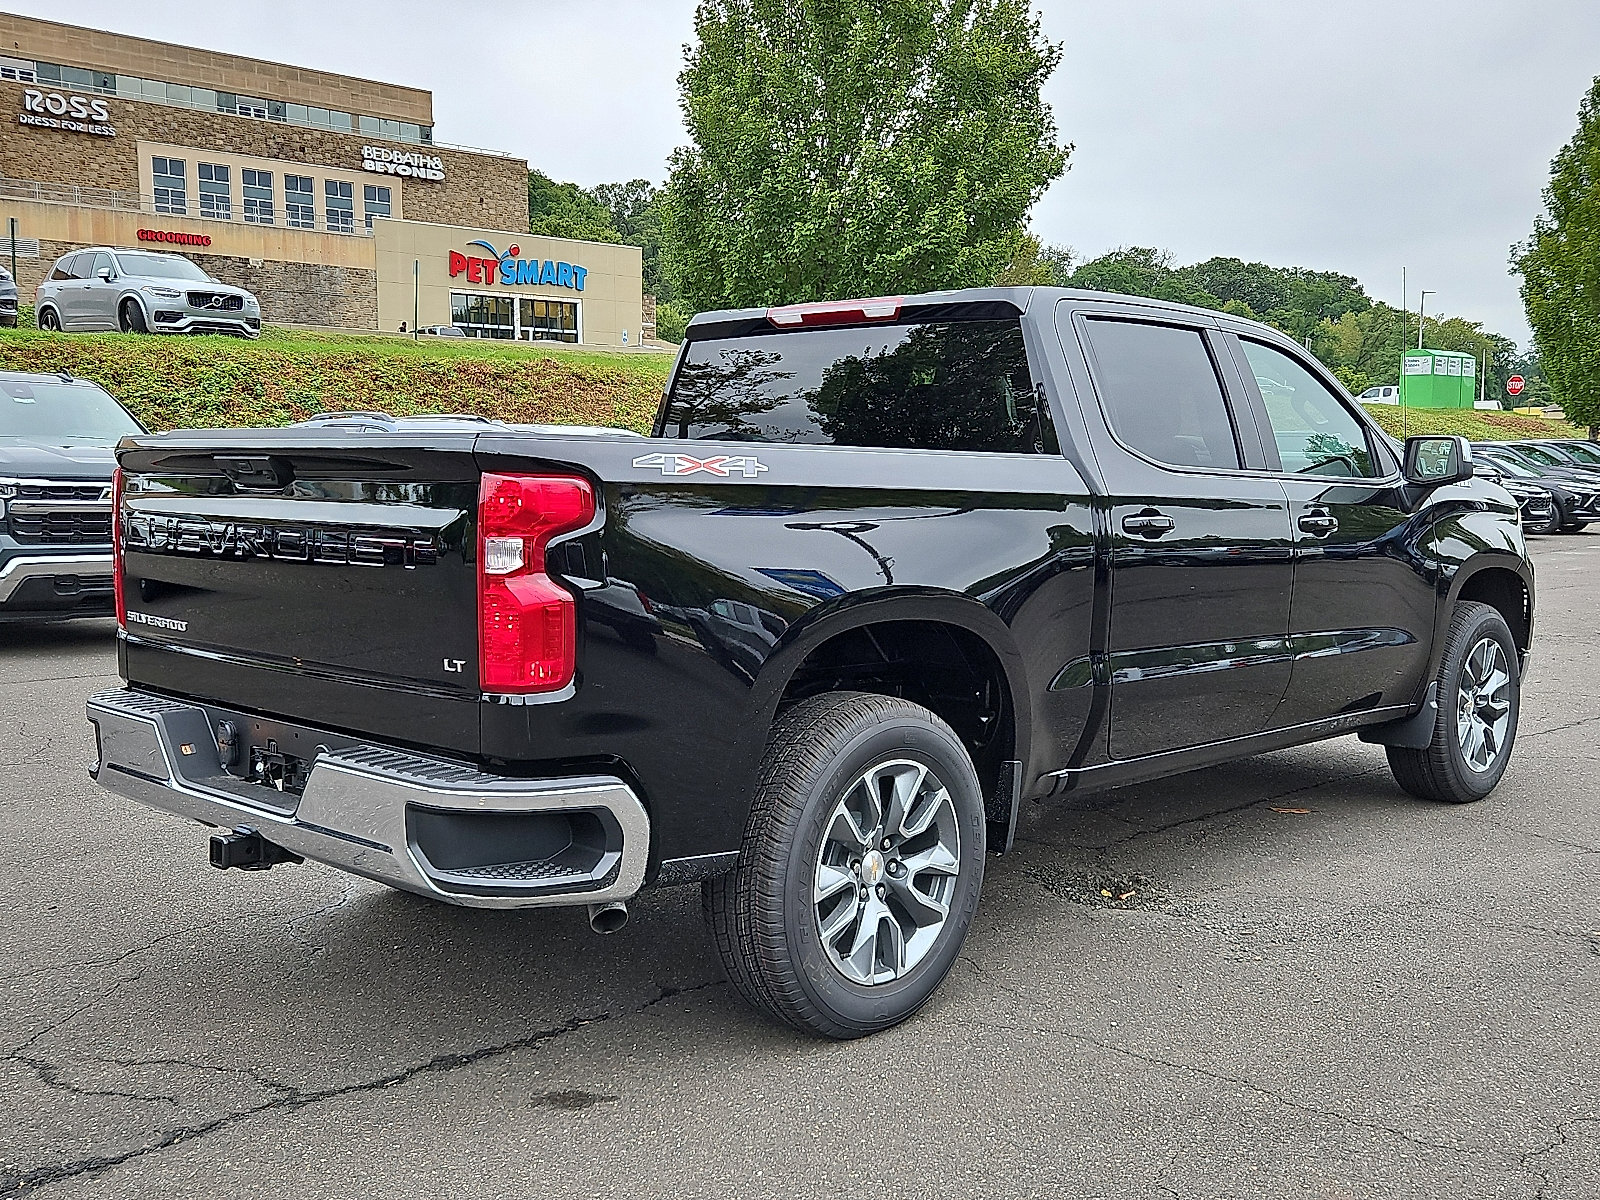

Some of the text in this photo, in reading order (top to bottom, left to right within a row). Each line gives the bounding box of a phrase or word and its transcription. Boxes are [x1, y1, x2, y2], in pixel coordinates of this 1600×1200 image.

[24, 89, 109, 121] ROSS
[19, 113, 117, 137] DRESS FOR LESS
[362, 159, 446, 181] BEYOND
[137, 228, 212, 247] GROOMING
[448, 249, 588, 292] PETSMART
[1508, 381, 1525, 390] STOP
[126, 512, 437, 570] CHEVROLET
[126, 610, 189, 632] SILVERADO
[442, 657, 467, 674] LT
